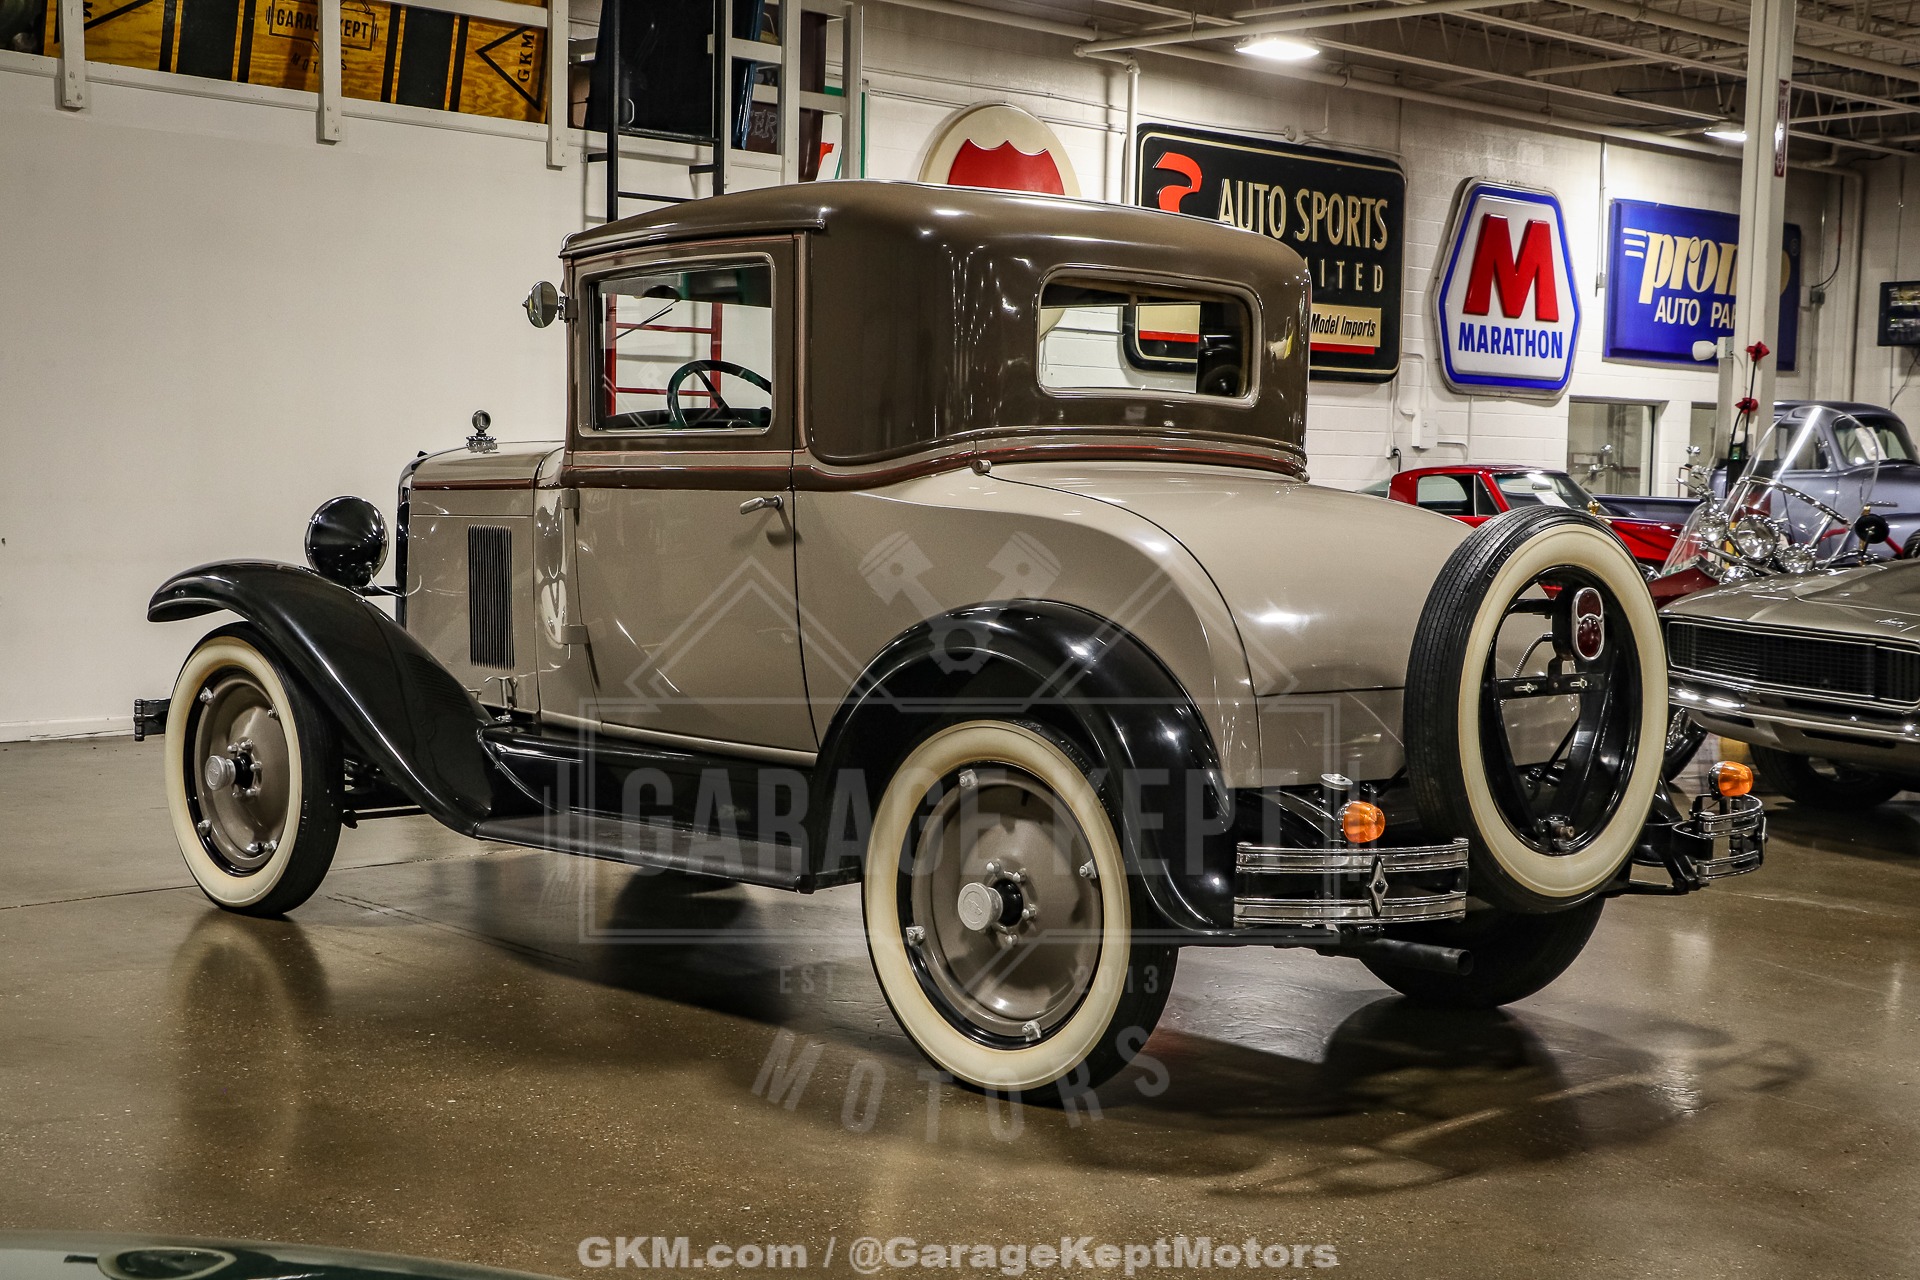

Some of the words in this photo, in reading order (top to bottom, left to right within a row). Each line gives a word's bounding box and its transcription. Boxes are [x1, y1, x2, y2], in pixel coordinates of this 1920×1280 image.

[517, 34, 535, 82] GKM
[1218, 178, 1287, 239] AUTO
[1294, 188, 1389, 251] SPORTS
[1304, 256, 1384, 293] ITED
[1462, 212, 1559, 322] M
[1310, 313, 1340, 335] Model
[1340, 316, 1377, 339] Imports
[1654, 295, 1701, 327] AUTO
[1458, 321, 1563, 359] MARATHON
